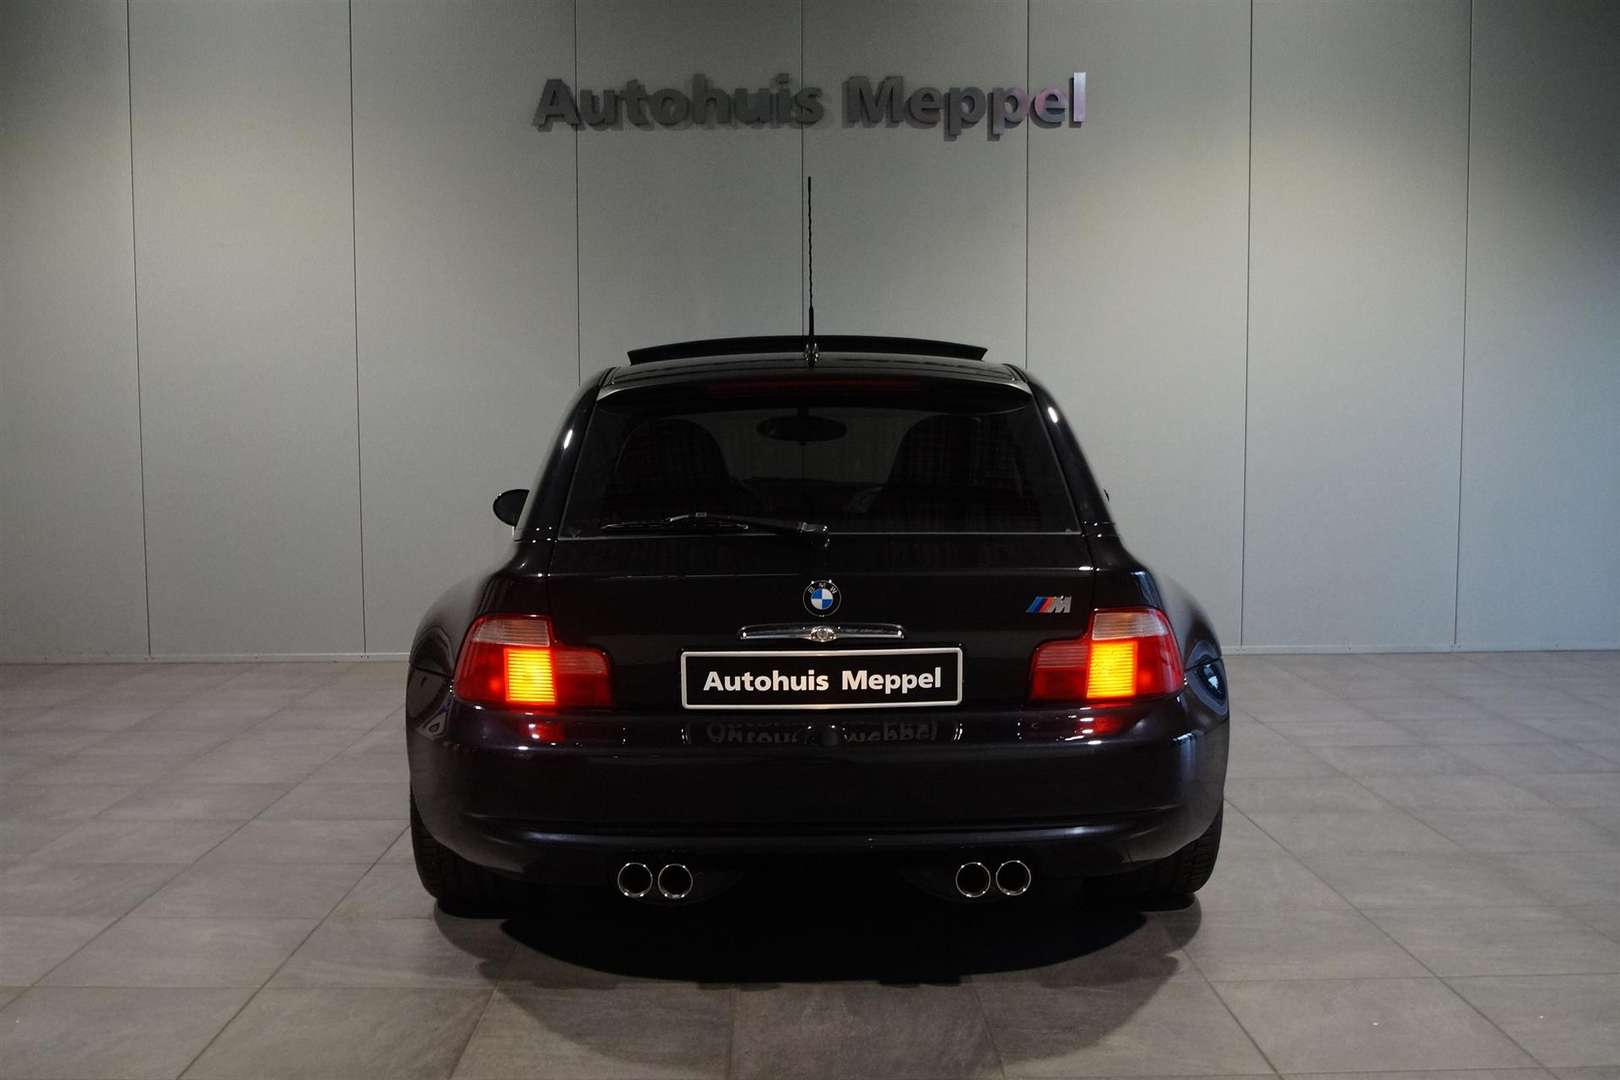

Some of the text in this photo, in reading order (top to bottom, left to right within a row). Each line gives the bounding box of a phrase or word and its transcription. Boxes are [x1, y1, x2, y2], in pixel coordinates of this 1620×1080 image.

[534, 71, 1088, 141] Autohuis Meppel
[1040, 596, 1072, 614] M
[702, 666, 942, 694] Autohuis Meppel
